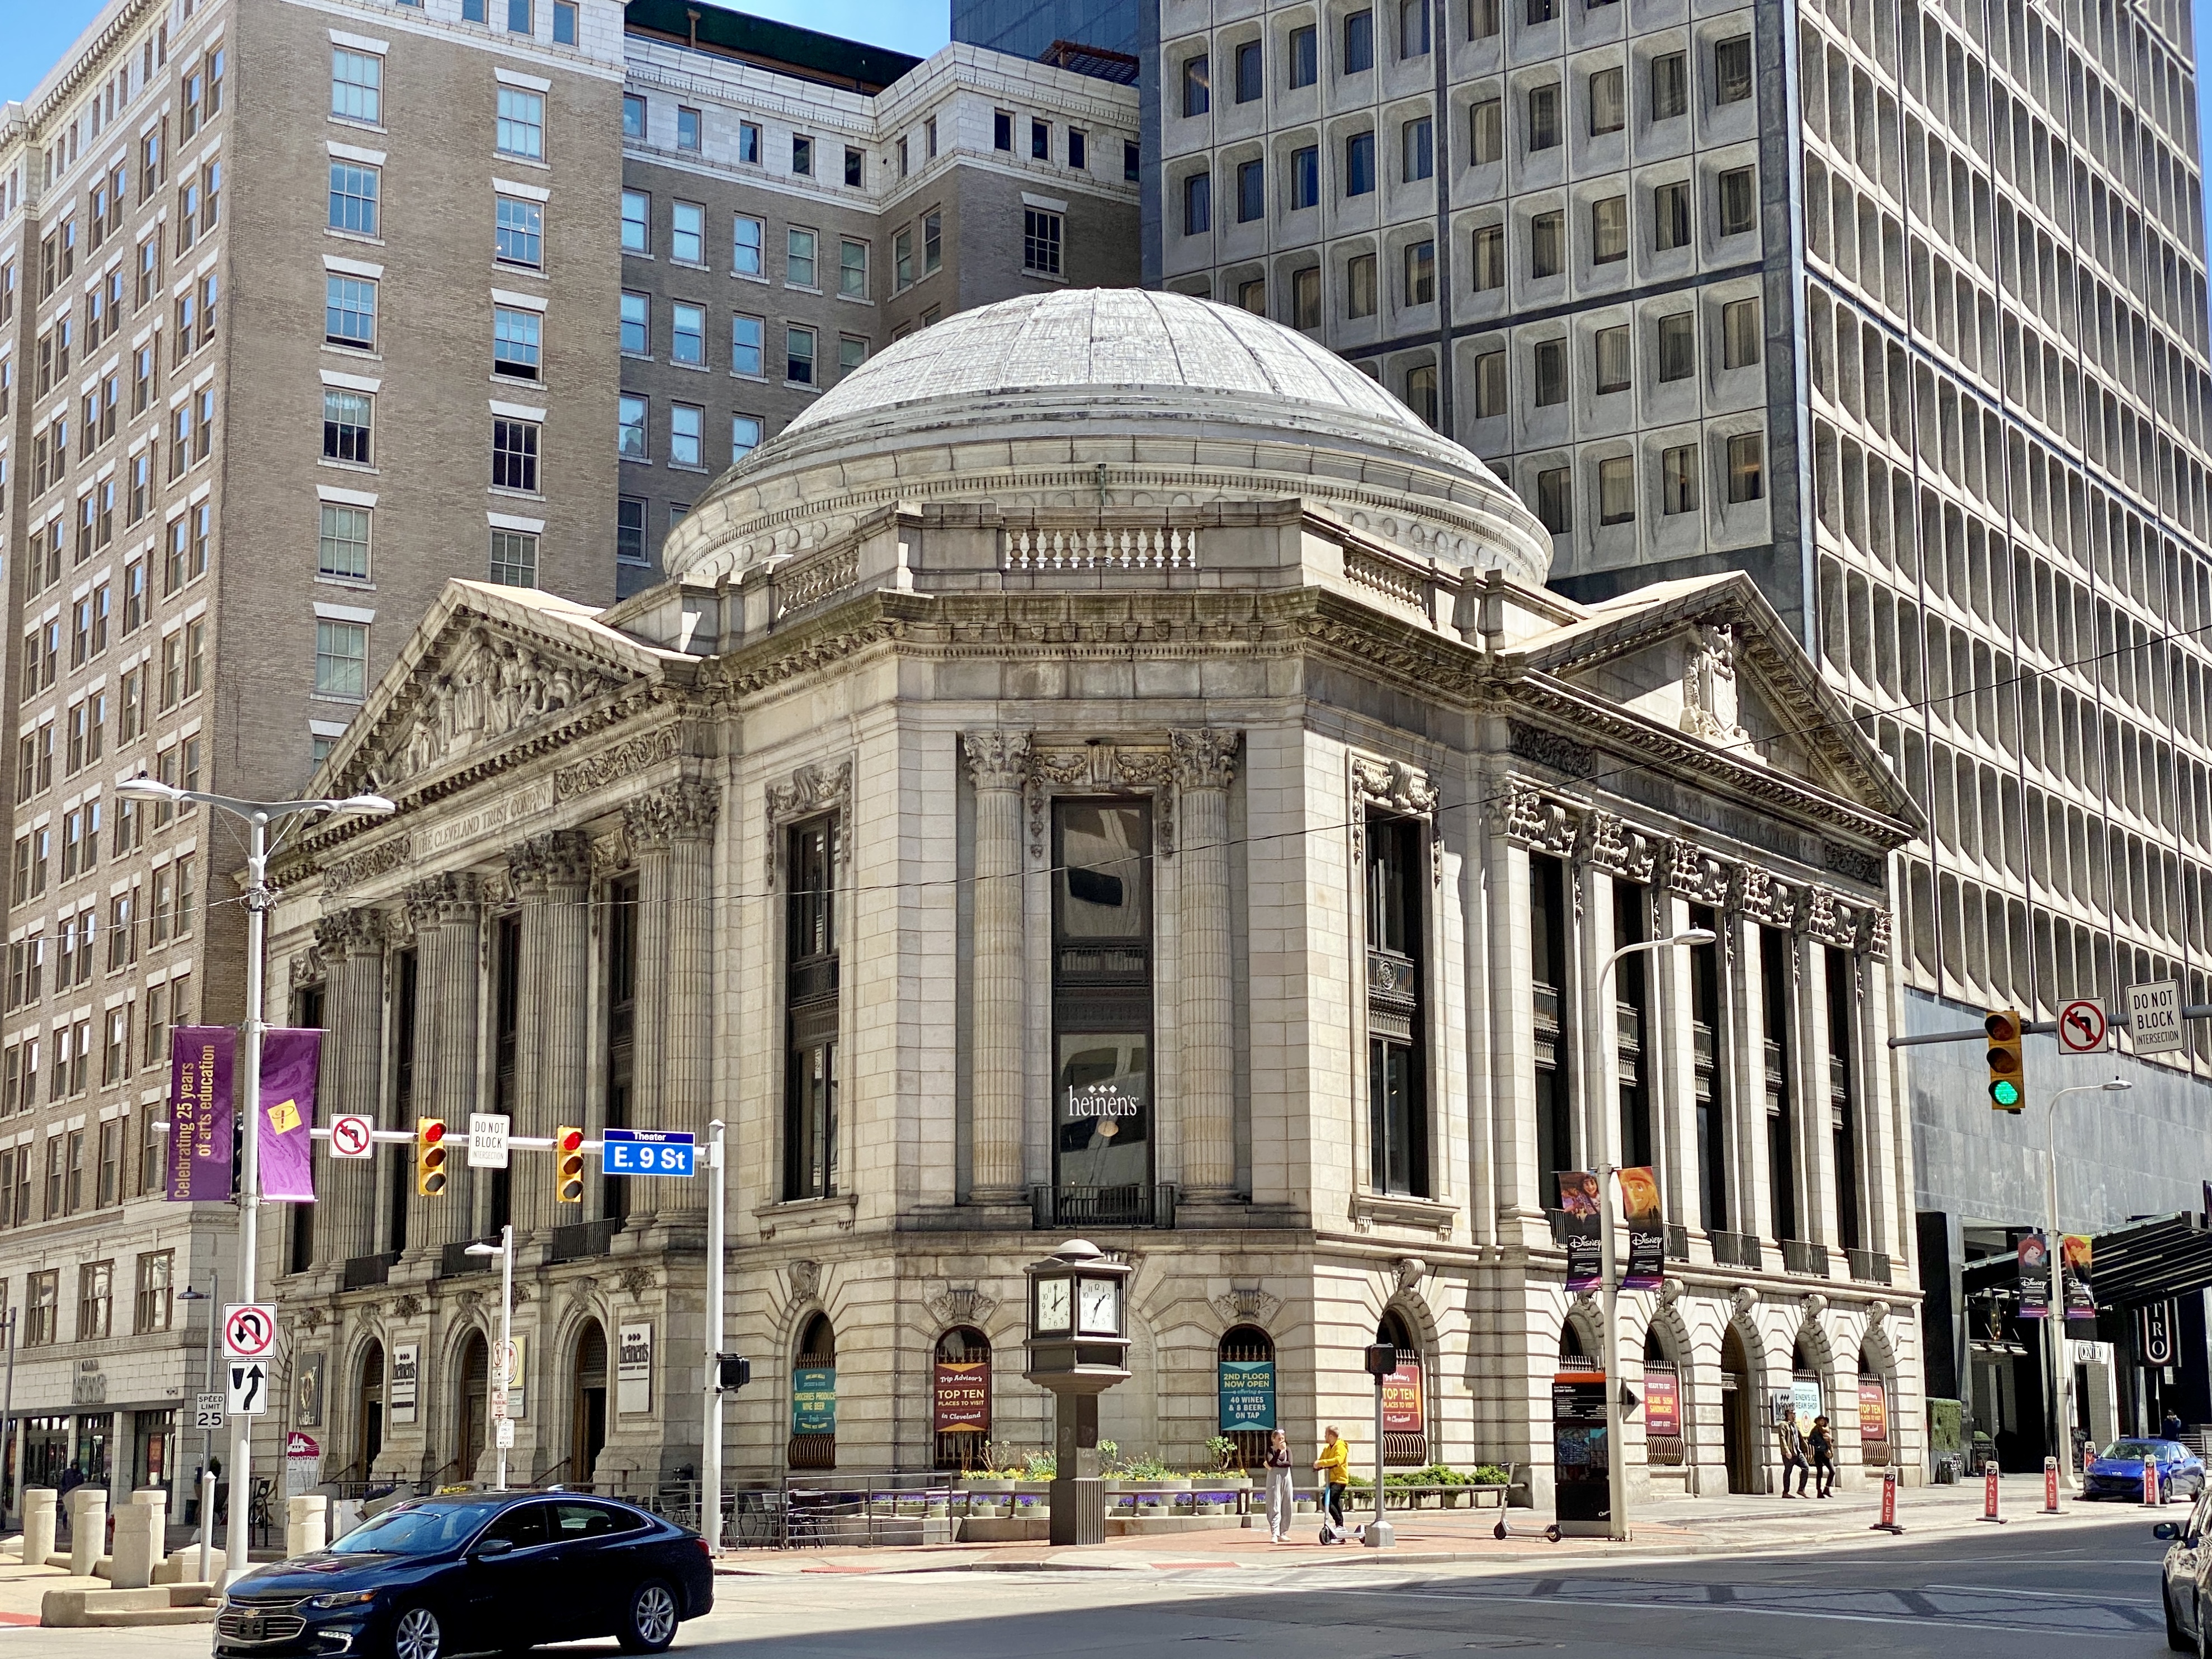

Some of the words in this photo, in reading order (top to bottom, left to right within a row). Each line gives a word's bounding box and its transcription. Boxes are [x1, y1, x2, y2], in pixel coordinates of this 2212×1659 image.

[417, 831, 432, 854] THE
[435, 816, 480, 847] CLEVELAND
[482, 803, 509, 830] TRUST
[511, 786, 553, 818] COMPANY
[2133, 993, 2148, 1010] DO
[2151, 990, 2172, 1007] NOT
[2137, 1010, 2175, 1030] BLOCK
[2136, 1030, 2179, 1045] INTERSECTION
[180, 1062, 196, 1100] years
[197, 1045, 215, 1110] education
[1068, 1085, 1138, 1116] heinen's
[177, 1102, 193, 1119] 25
[197, 1114, 211, 1140] arts
[475, 1121, 486, 1133] DO
[488, 1122, 504, 1134] NOT
[475, 1136, 502, 1148] BLOCK
[633, 1131, 667, 1142] Theater
[196, 1143, 211, 1157] of
[472, 1151, 503, 1160] INTERSECTION
[174, 1122, 195, 1198] Celebrating
[615, 1146, 634, 1168] E.
[639, 1147, 654, 1168] 9
[661, 1148, 685, 1170] St
[1568, 1234, 1602, 1252] Disney
[1630, 1232, 1663, 1249] Disney
[2020, 1276, 2047, 1290] Disney
[937, 1390, 961, 1399] TOP
[962, 1389, 984, 1398] TEN
[1382, 1388, 1398, 1400] TOP
[1399, 1388, 1415, 1400] TEN
[1647, 1396, 1661, 1404] SALADS
[949, 1411, 981, 1420] Cleveland
[1860, 1403, 1870, 1414] TOP
[1870, 1404, 1881, 1414] TEN
[197, 1412, 222, 1426] 25
